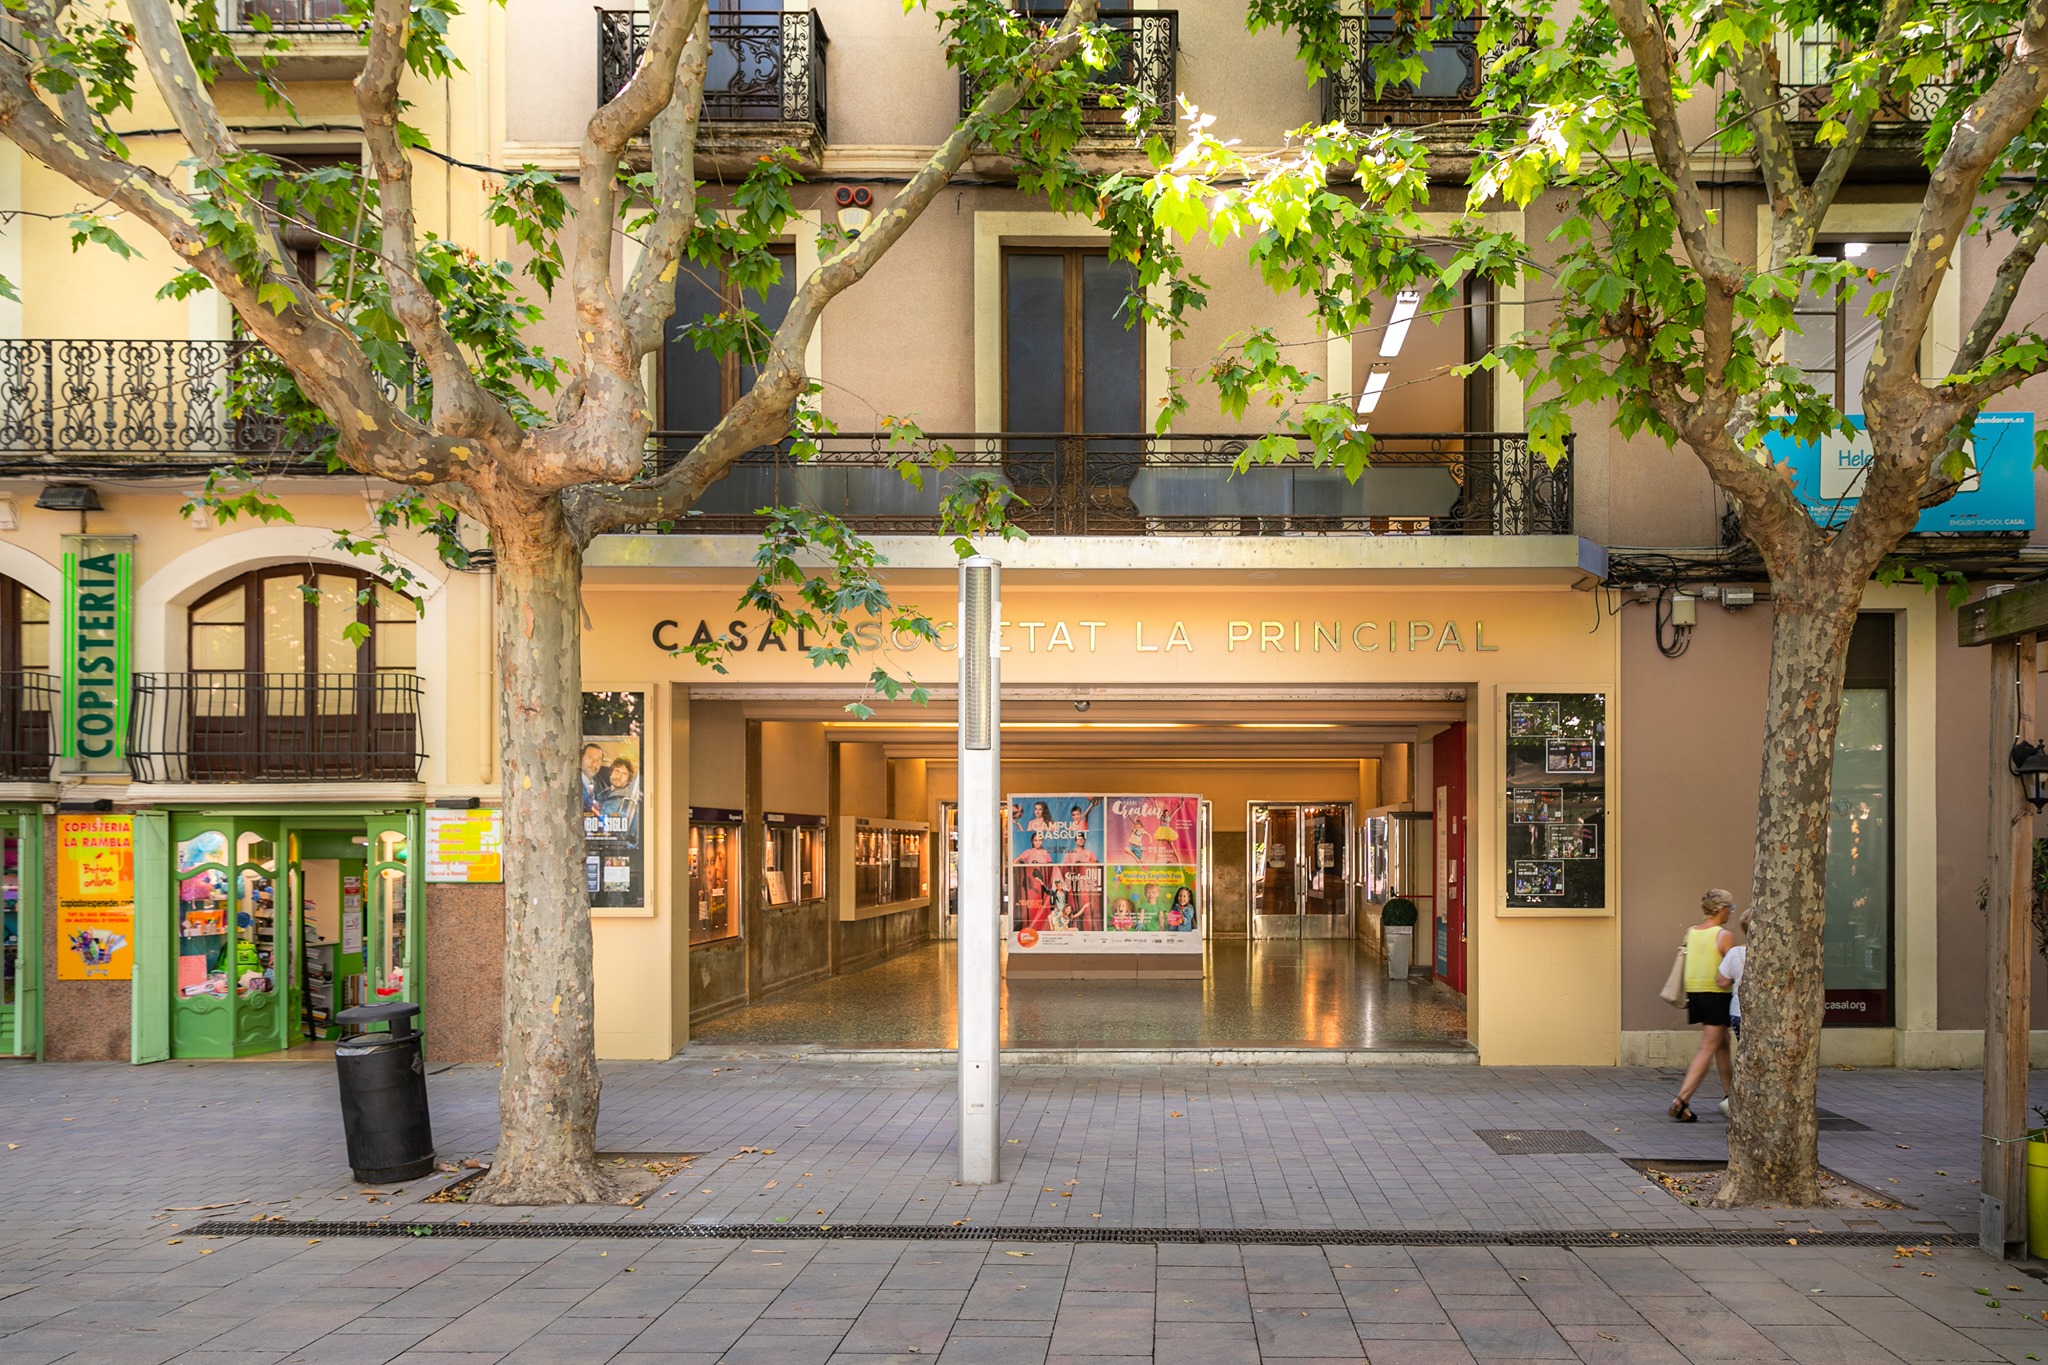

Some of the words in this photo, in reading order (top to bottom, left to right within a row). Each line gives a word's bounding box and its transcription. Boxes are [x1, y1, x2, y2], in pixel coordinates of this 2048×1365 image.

[1950, 519, 1975, 527] ENGLISH
[1976, 518, 2003, 526] SCHOOL
[2005, 518, 2025, 526] CASAL
[652, 619, 812, 652] CASAL
[855, 620, 1106, 652] SOCETAT
[1136, 621, 1193, 652] LA
[1227, 621, 1499, 652] PRINCIPAL
[77, 553, 115, 758] COPISTERIA
[64, 823, 130, 832] COPISTERIA
[1031, 821, 1078, 831] CAMPUS
[1036, 830, 1089, 840] BASQUET
[64, 838, 77, 847] LA
[82, 838, 130, 847] RAMBLA
[1824, 1001, 1866, 1011] casal.org
